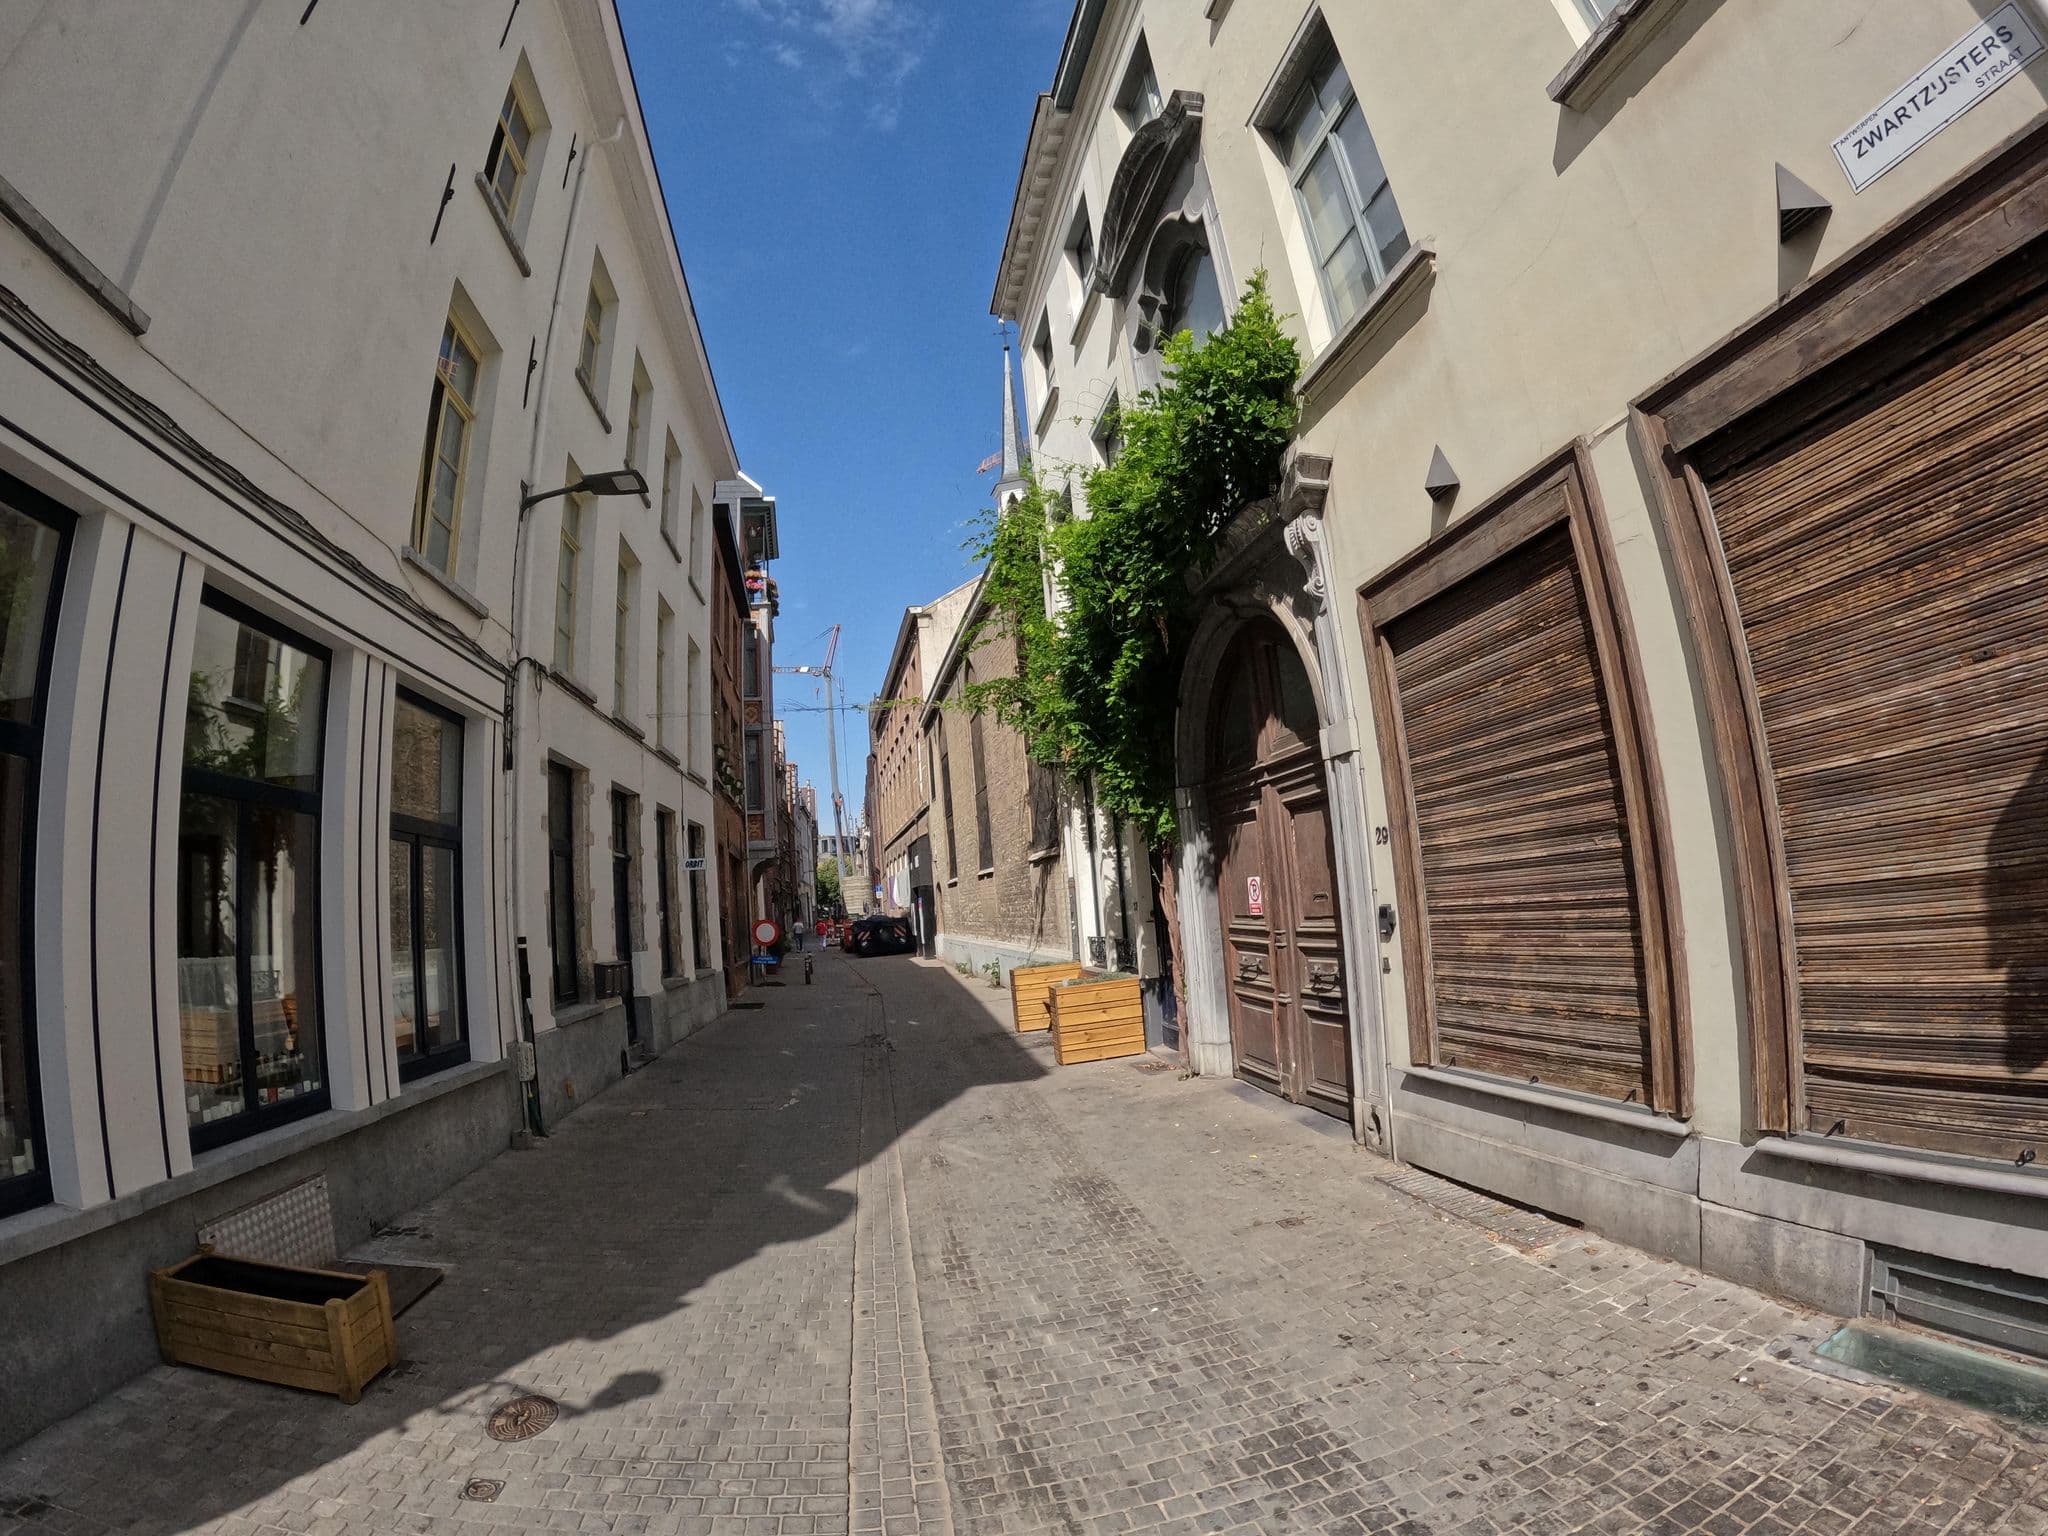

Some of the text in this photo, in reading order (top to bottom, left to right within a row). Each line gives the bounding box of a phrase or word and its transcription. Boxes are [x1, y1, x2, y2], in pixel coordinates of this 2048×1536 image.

[1975, 46, 2024, 88] STRAAT
[1840, 112, 1878, 145] ANTWERPEN
[1376, 827, 1389, 845] 29
[685, 860, 704, 868] ORBIT
